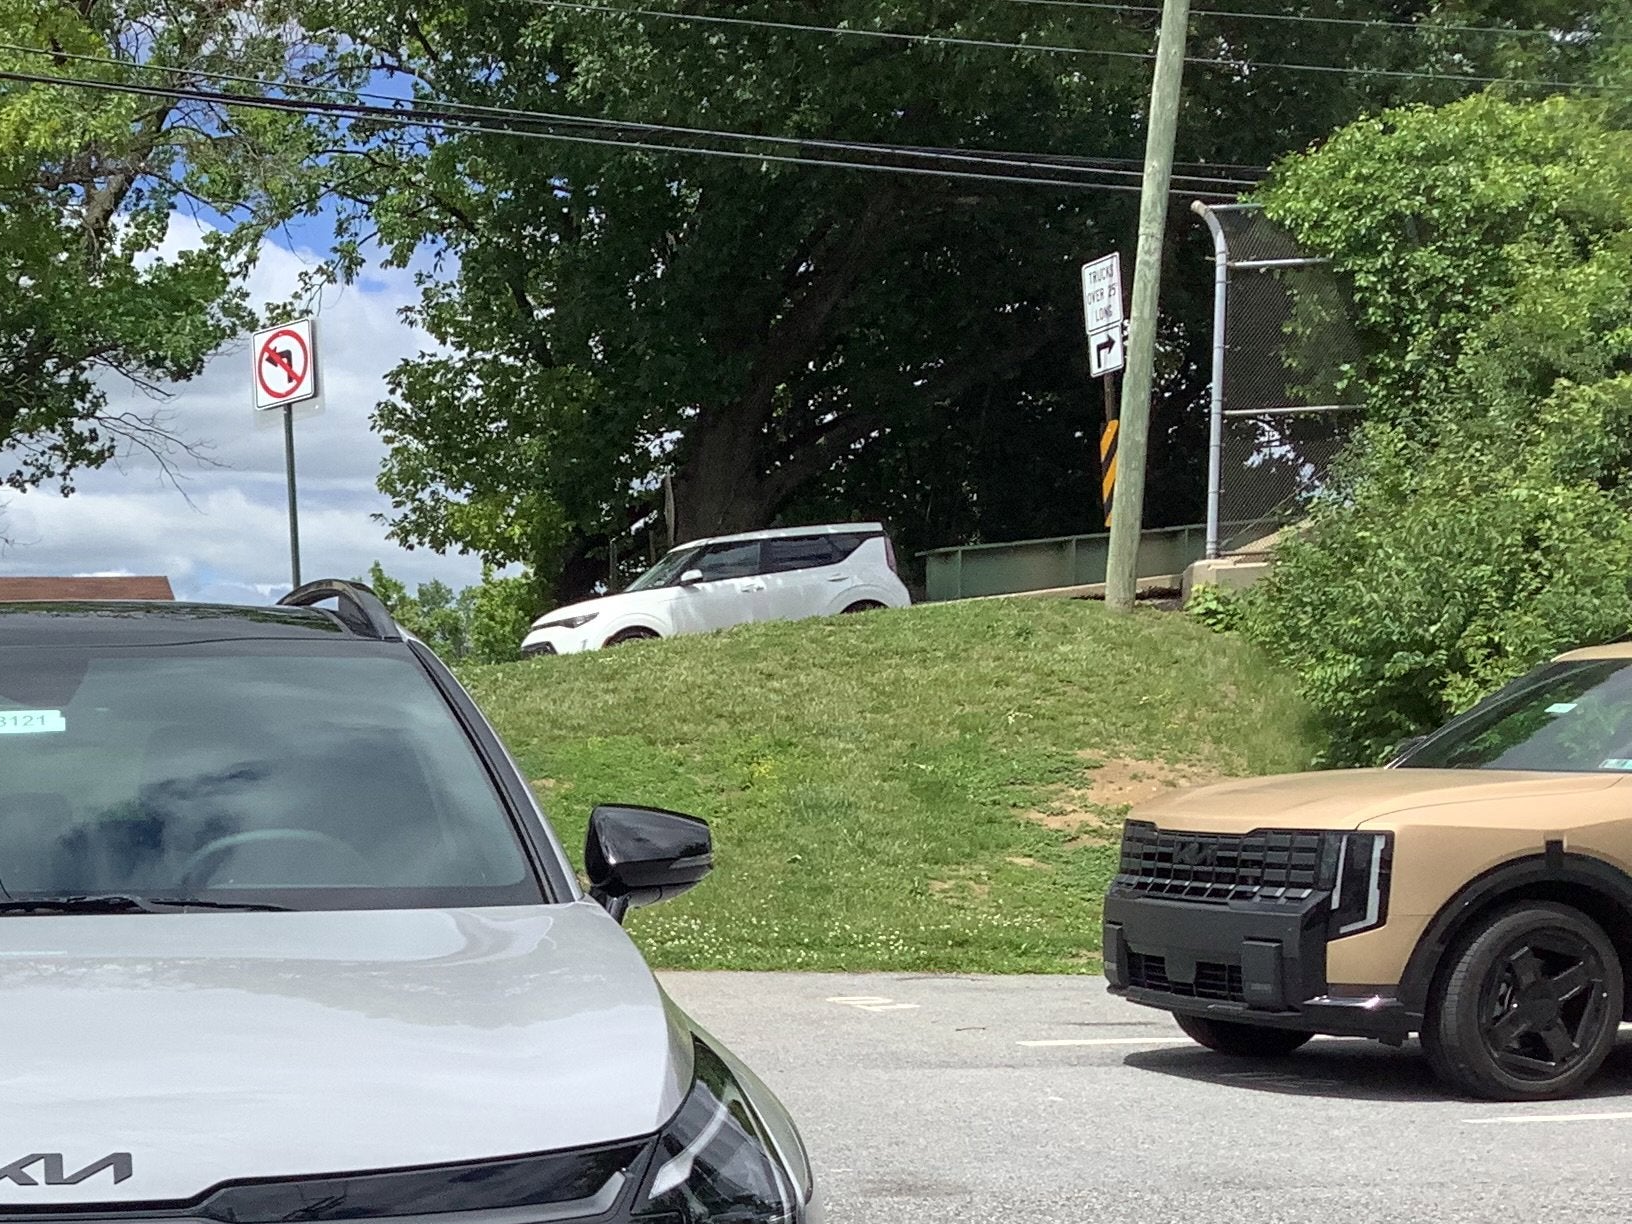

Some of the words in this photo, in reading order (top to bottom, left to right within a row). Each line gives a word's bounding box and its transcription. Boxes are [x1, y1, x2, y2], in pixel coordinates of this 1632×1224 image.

[1088, 264, 1114, 283] TRUCKS
[1087, 287, 1105, 305] OVER
[1095, 304, 1113, 322] LONG
